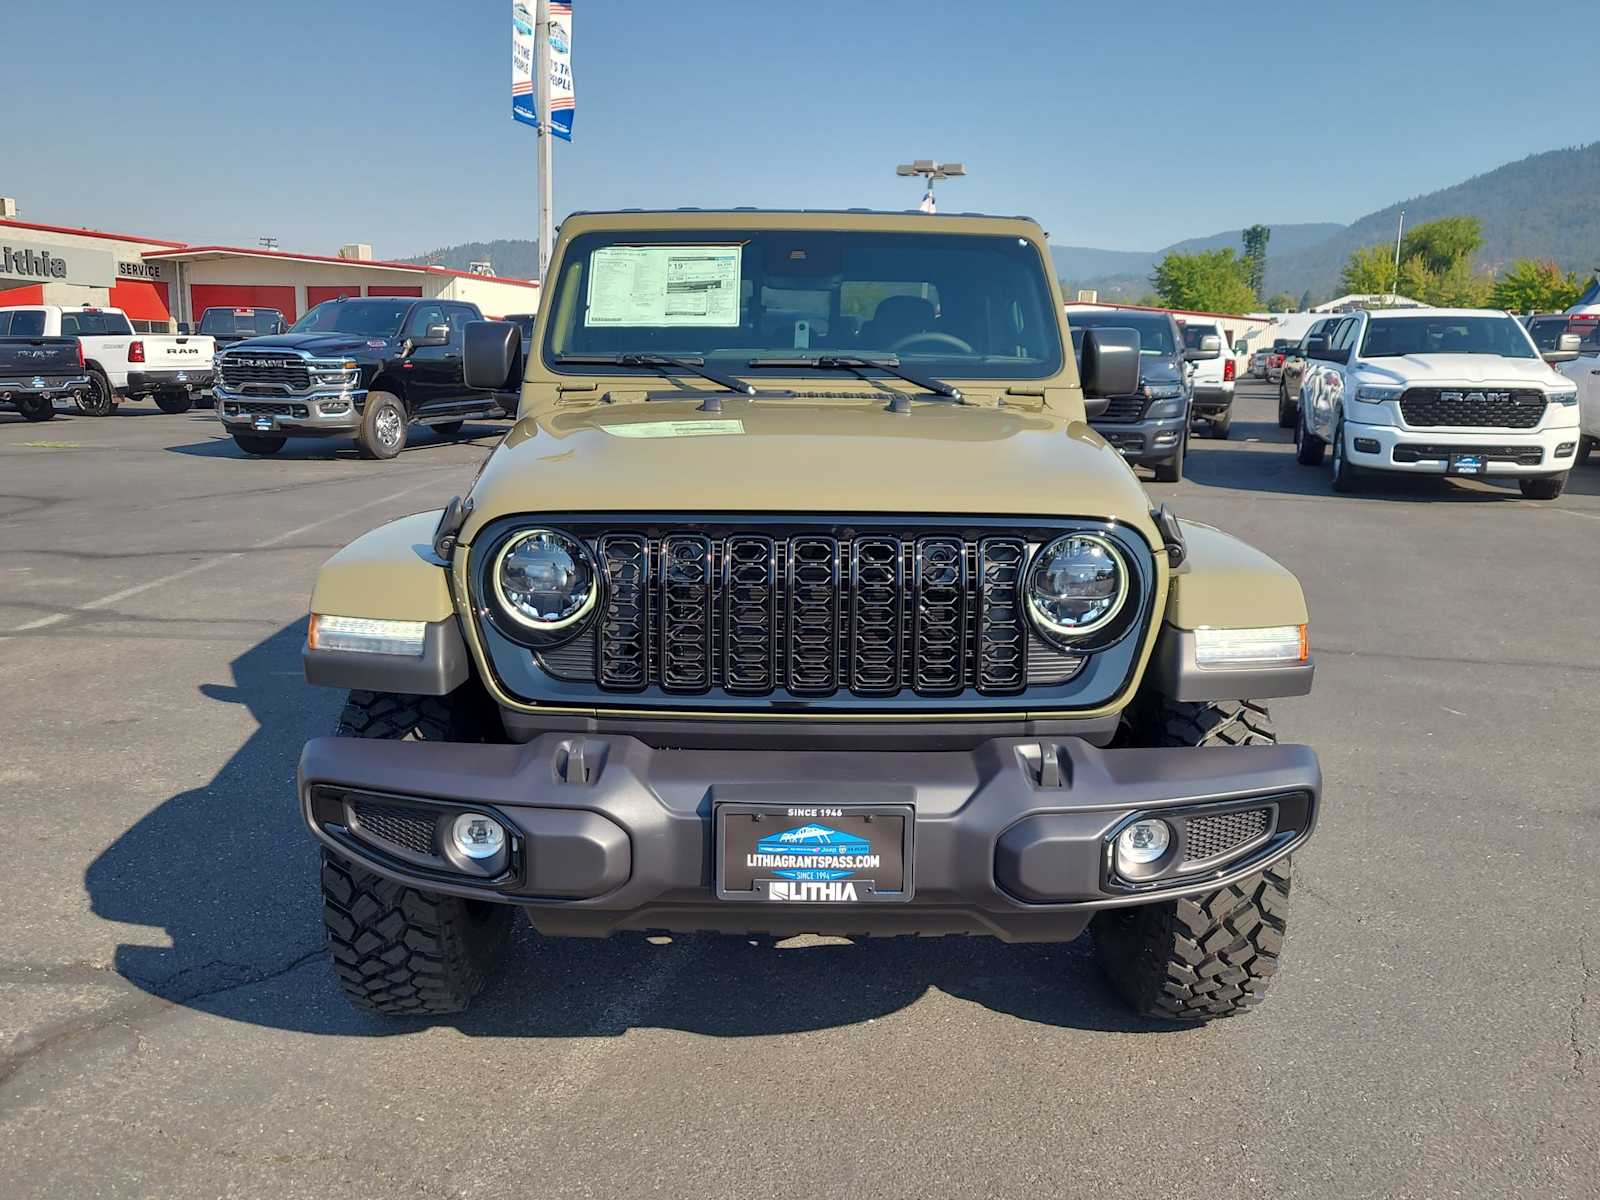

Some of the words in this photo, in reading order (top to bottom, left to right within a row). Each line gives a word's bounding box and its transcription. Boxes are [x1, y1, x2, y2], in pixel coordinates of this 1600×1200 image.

[120, 263, 160, 277] SERVICE
[1440, 391, 1511, 402] RAM
[787, 808, 818, 817] SINCE
[820, 808, 843, 817] 1946
[746, 854, 880, 869] LITHIAGRANTSPASS.COM
[796, 871, 814, 880] SINCE
[816, 871, 830, 880] 1994
[789, 882, 859, 901] LITHIA
